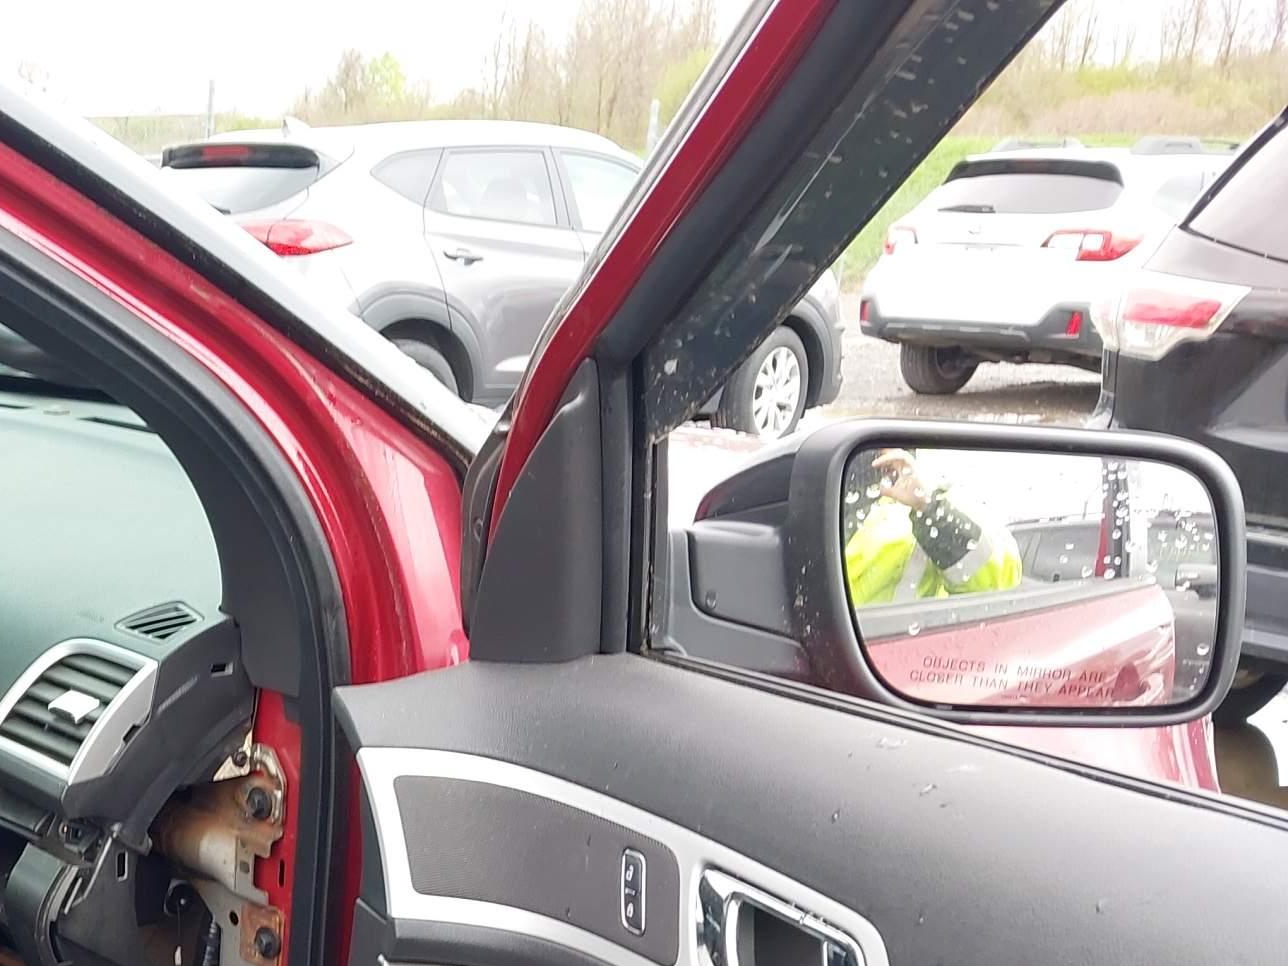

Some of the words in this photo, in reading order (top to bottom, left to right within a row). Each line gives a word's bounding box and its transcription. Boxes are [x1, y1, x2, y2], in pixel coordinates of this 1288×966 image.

[922, 656, 986, 671] OBJECTS
[994, 664, 1009, 676] IN
[1016, 665, 1072, 681] MIRROR
[1079, 671, 1106, 683] ARE
[909, 671, 964, 686] CLOSER
[972, 676, 1009, 690] THAN
[1017, 681, 1055, 695] THEY
[1059, 686, 1116, 699] APPEAR
